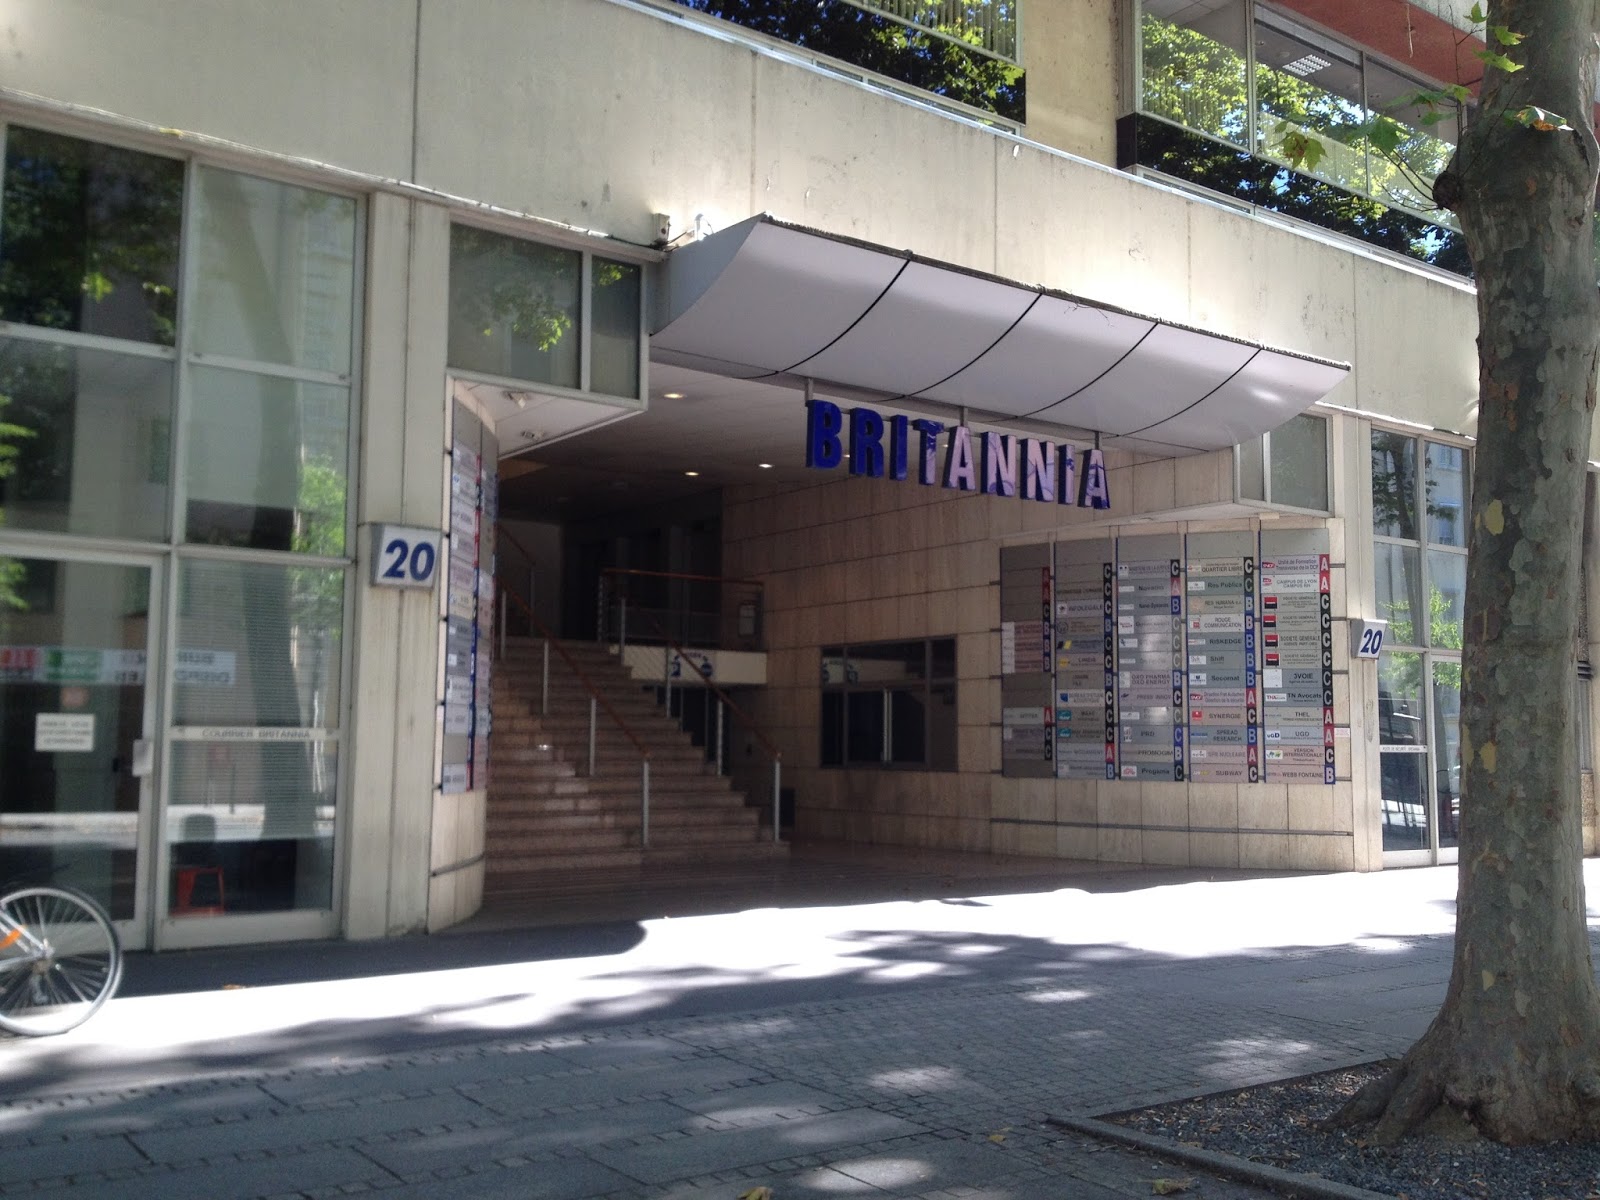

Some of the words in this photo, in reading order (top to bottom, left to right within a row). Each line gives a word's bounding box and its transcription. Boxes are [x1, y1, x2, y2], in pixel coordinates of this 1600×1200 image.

[806, 399, 1111, 509] BRITANNIA
[382, 537, 435, 582] 20
[1245, 559, 1253, 574] C
[1321, 557, 1329, 571] A
[1104, 566, 1111, 578] C
[1171, 561, 1179, 576] C
[1104, 582, 1112, 596] C
[1172, 579, 1180, 594] A
[1245, 577, 1253, 592] C
[1321, 576, 1329, 590] A
[1105, 600, 1112, 615] C
[1172, 598, 1180, 612] B
[1246, 596, 1253, 611] B
[1321, 594, 1330, 610] C
[1044, 604, 1050, 617] C
[1105, 619, 1111, 632] B
[1172, 616, 1180, 631] C
[1246, 615, 1253, 630] B
[1322, 613, 1330, 628] C
[1044, 621, 1050, 636] B
[1044, 639, 1050, 653] B
[1105, 636, 1112, 651] C
[1173, 635, 1181, 650] C
[1246, 634, 1254, 648] B
[1322, 632, 1331, 648] C
[1360, 628, 1383, 655] 20
[1044, 656, 1051, 671] B
[1105, 655, 1112, 669] C
[1173, 653, 1181, 668] C
[1247, 652, 1254, 667] B
[1323, 651, 1331, 667] C
[1106, 673, 1112, 687] B
[1174, 671, 1181, 687] B
[1247, 671, 1255, 686] B
[1323, 671, 1331, 686] C
[1106, 690, 1113, 705] C
[1174, 690, 1182, 705] C
[1247, 690, 1255, 705] A
[1324, 690, 1332, 705] C
[1045, 709, 1051, 723] A
[1106, 709, 1113, 723] C
[1174, 708, 1182, 722] C
[1248, 708, 1256, 723] C
[1325, 709, 1333, 724] A
[202, 729, 254, 738] COURRIER
[258, 729, 310, 738] BRITANNIA
[1045, 727, 1052, 741] C
[1106, 727, 1114, 741] C
[1175, 727, 1182, 742] C
[1248, 728, 1256, 743] B
[1325, 728, 1333, 743] A
[1045, 744, 1052, 758] C
[1106, 745, 1113, 760] A
[1175, 746, 1182, 761] B
[1249, 747, 1257, 762] A
[1326, 748, 1334, 763] C
[1107, 764, 1114, 778] B
[1175, 765, 1183, 779] C
[1249, 766, 1258, 781] C
[1326, 767, 1334, 783] B
